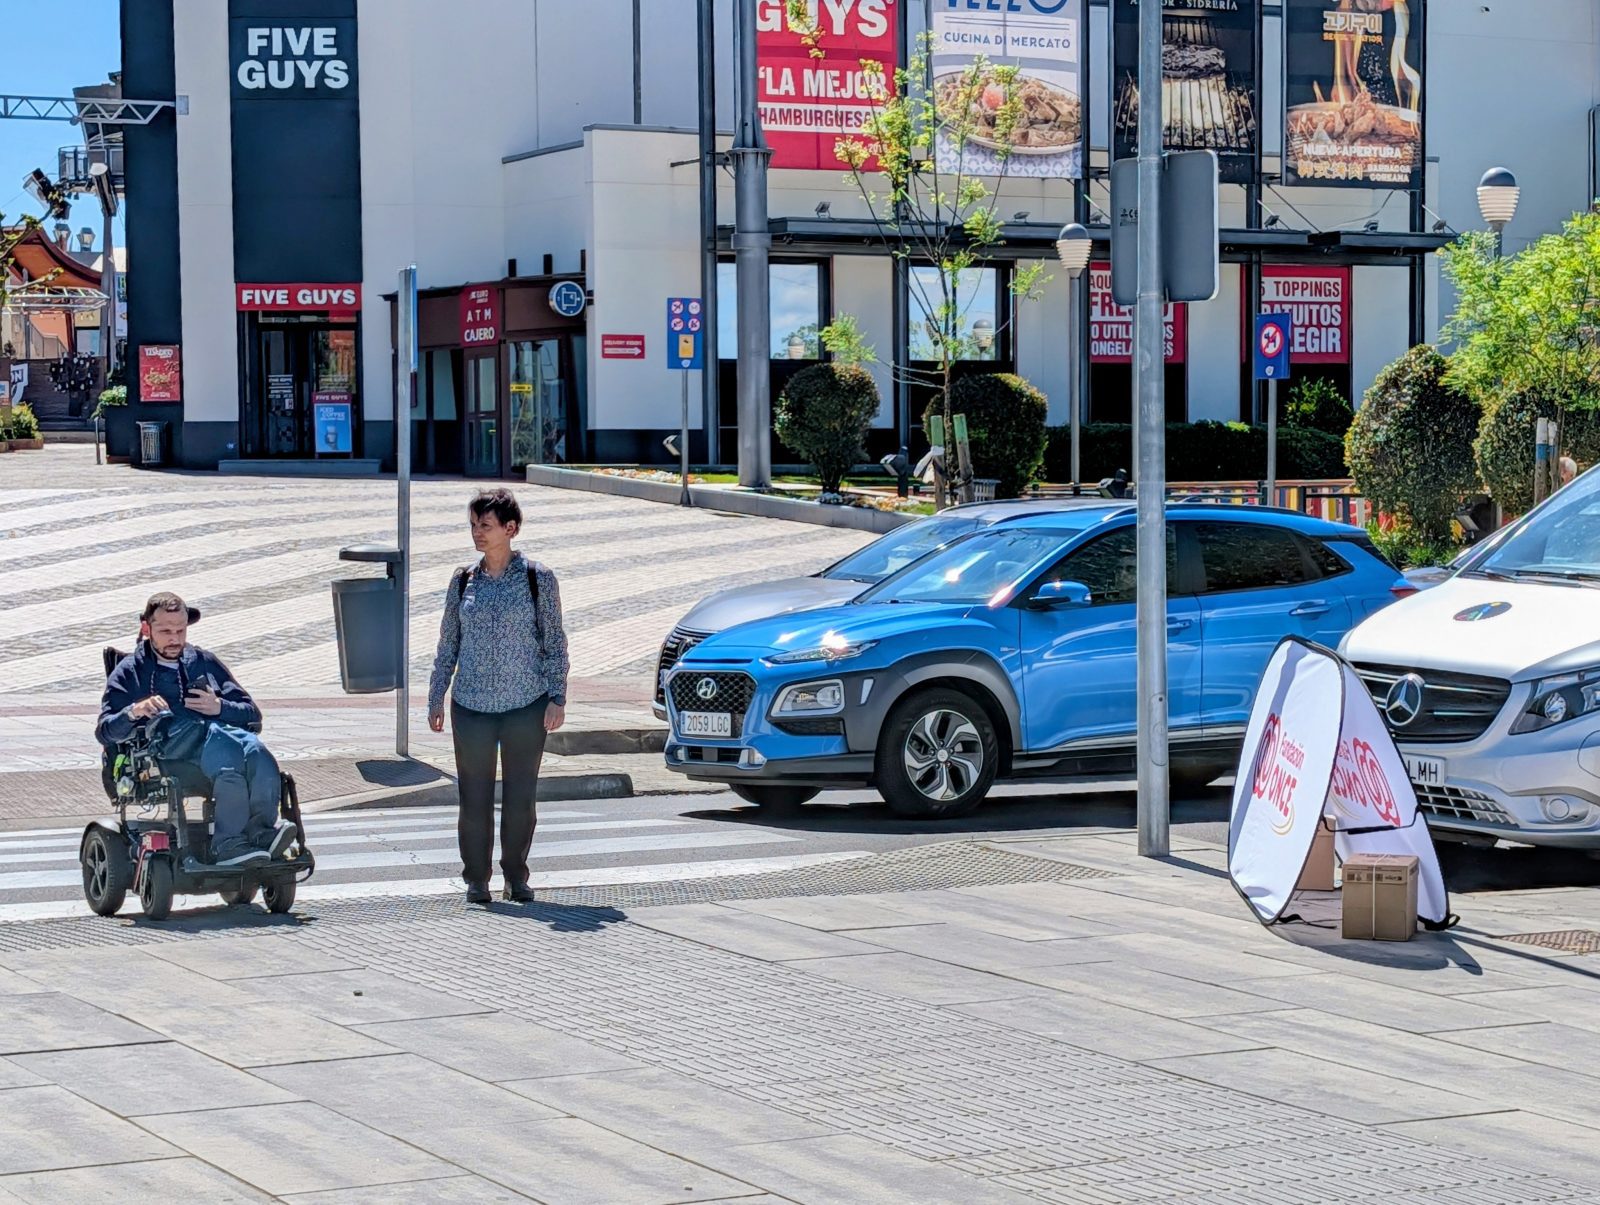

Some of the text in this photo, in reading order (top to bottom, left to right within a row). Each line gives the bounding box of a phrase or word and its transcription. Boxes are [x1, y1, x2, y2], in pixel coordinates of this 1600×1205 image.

[1323, 10, 1383, 33] 고기구이
[248, 27, 338, 56] FIVE
[944, 32, 1071, 49] CUCINA DI MERCATO
[237, 60, 349, 90] GUYS
[803, 68, 887, 100] MEJOR
[1303, 143, 1402, 159] NUEVA APERTURA
[1090, 275, 1111, 290] AQU
[1274, 281, 1340, 298] TOPPINGS
[242, 288, 356, 305] FIVE GUYS
[464, 327, 495, 342] CAJERO
[687, 715, 729, 733] 2059 LGC
[1407, 760, 1438, 783] LMH
[1268, 764, 1297, 817] ONCE
